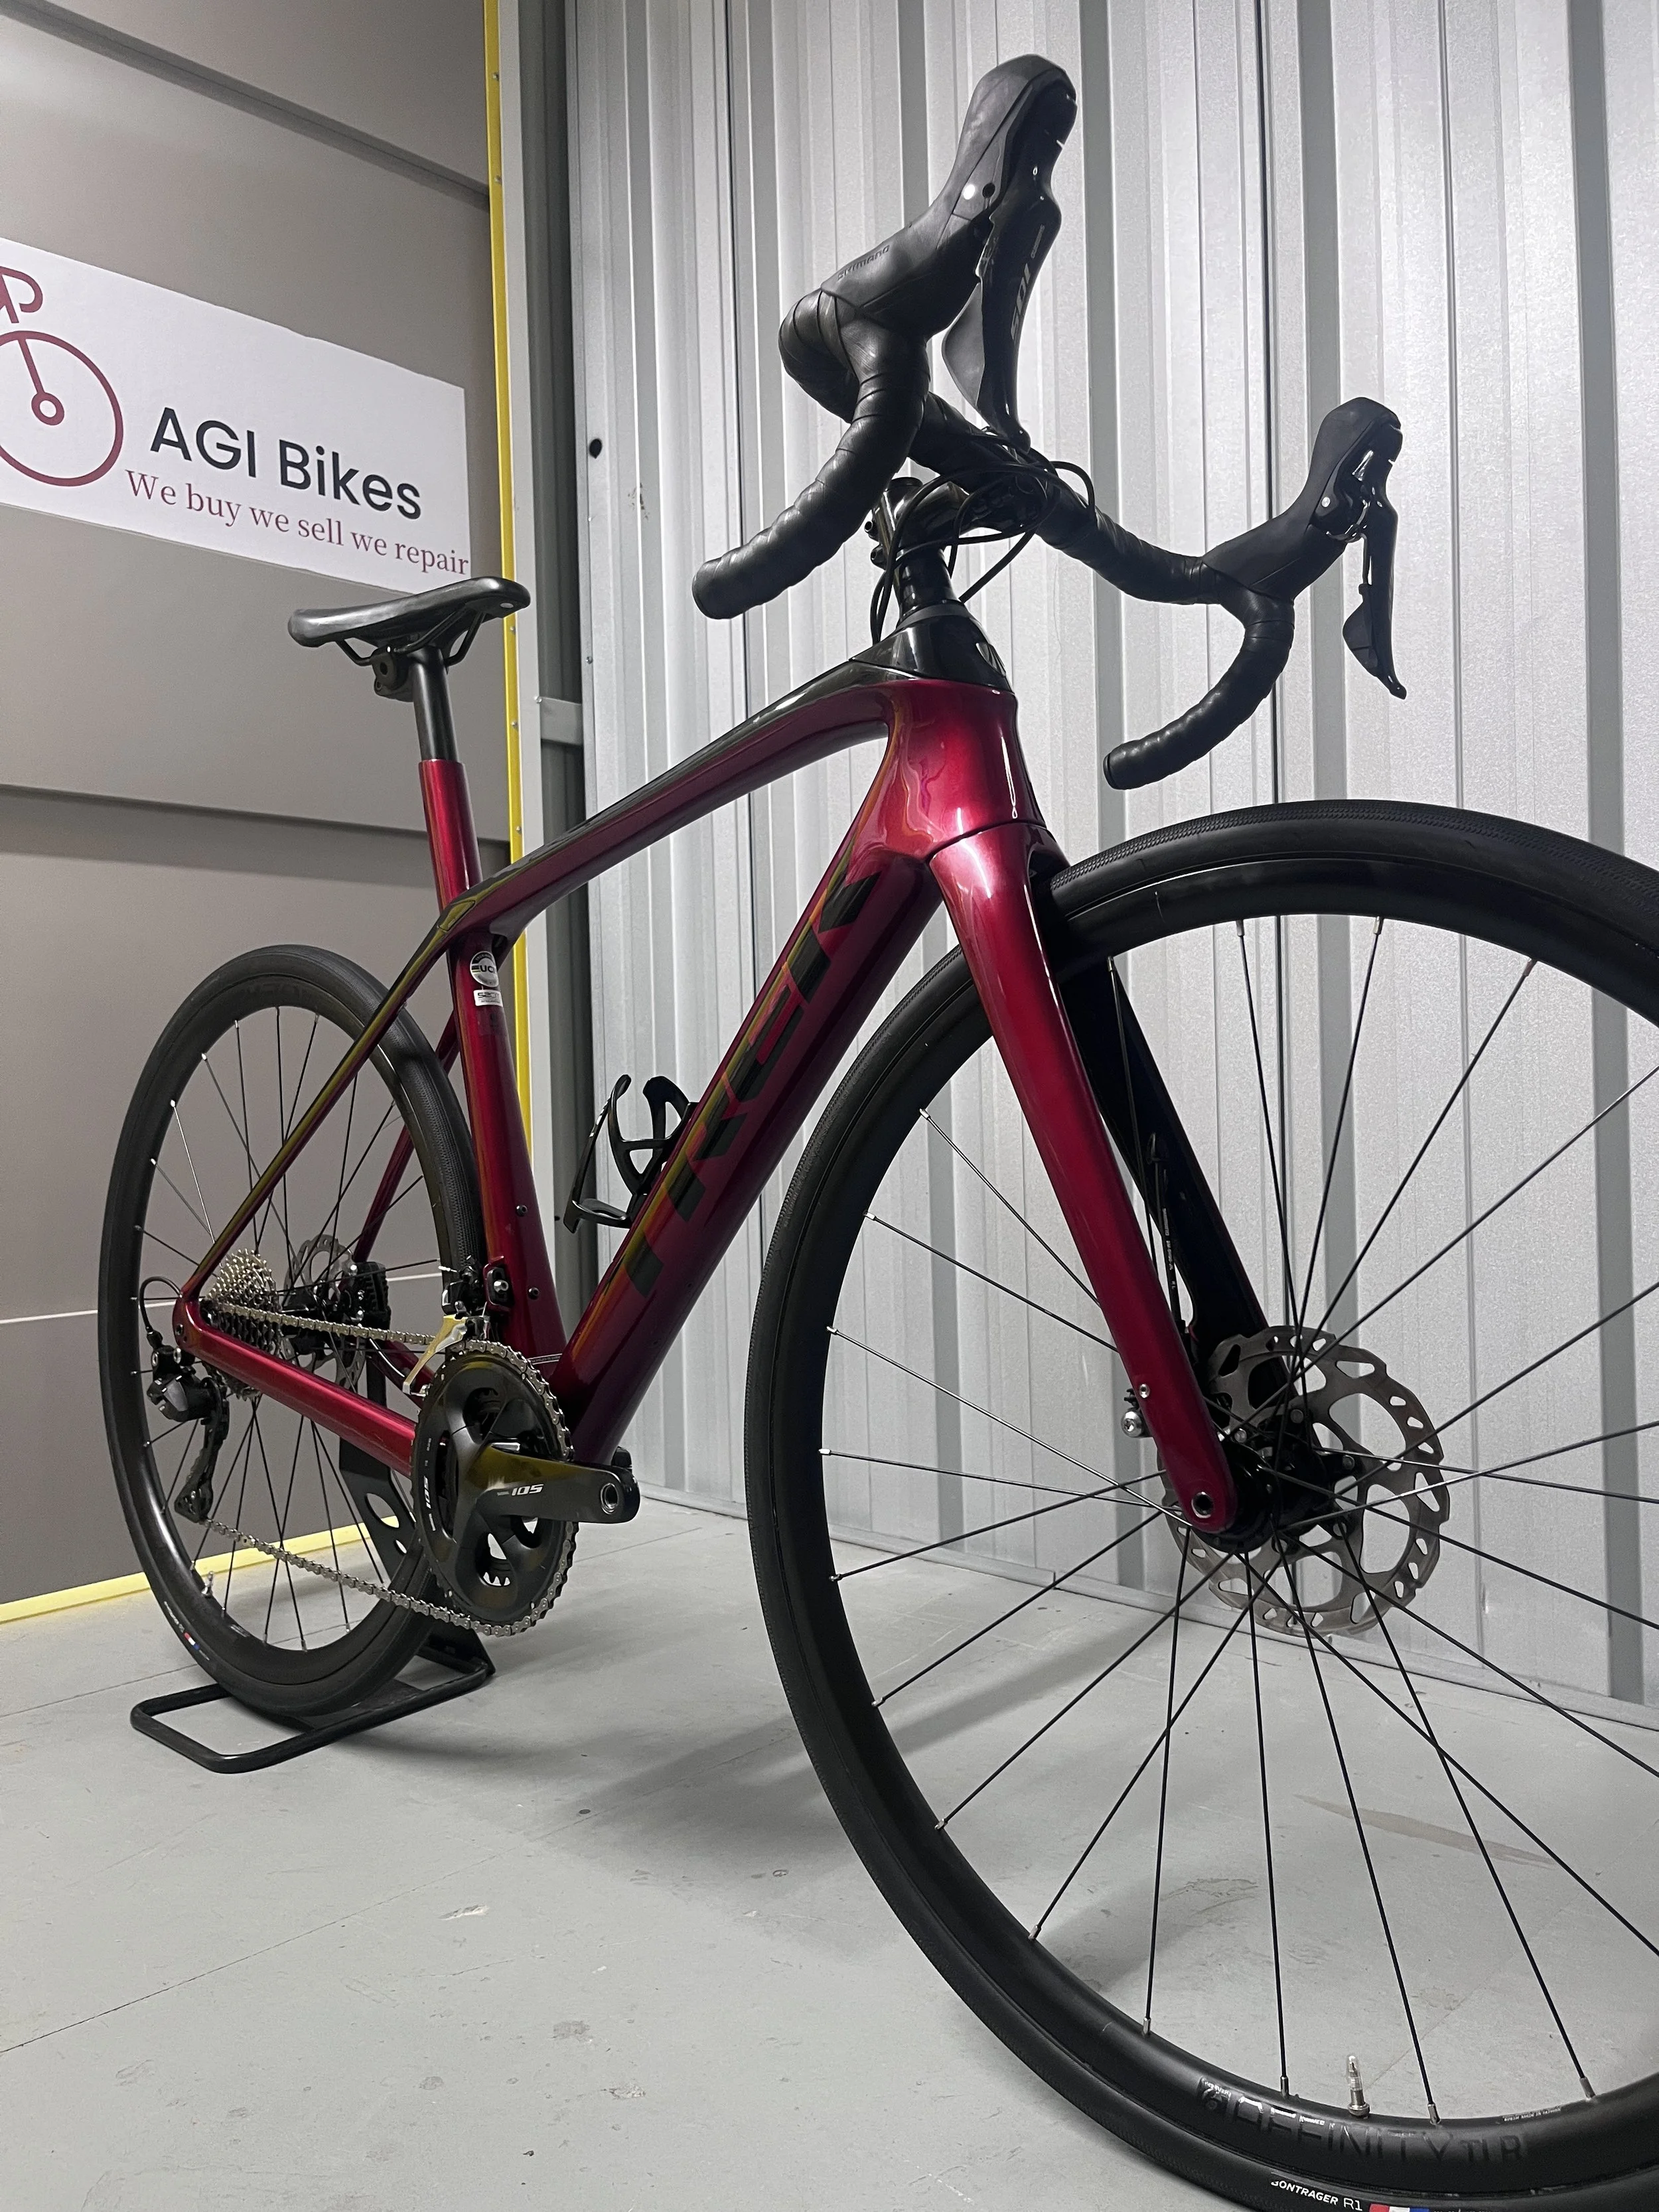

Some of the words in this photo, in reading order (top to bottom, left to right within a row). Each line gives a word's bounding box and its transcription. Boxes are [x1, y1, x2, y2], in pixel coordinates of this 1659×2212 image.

[150, 407, 256, 478] AGI
[280, 438, 421, 520] Bikes
[125, 469, 177, 506] We
[186, 482, 242, 527] buy
[250, 508, 290, 532] we
[298, 518, 344, 547] sell
[350, 534, 388, 557] we
[394, 542, 469, 575] repair
[614, 861, 883, 1298] TREK
[512, 1483, 544, 1496] 105
[1343, 2197, 1363, 2211] R1
